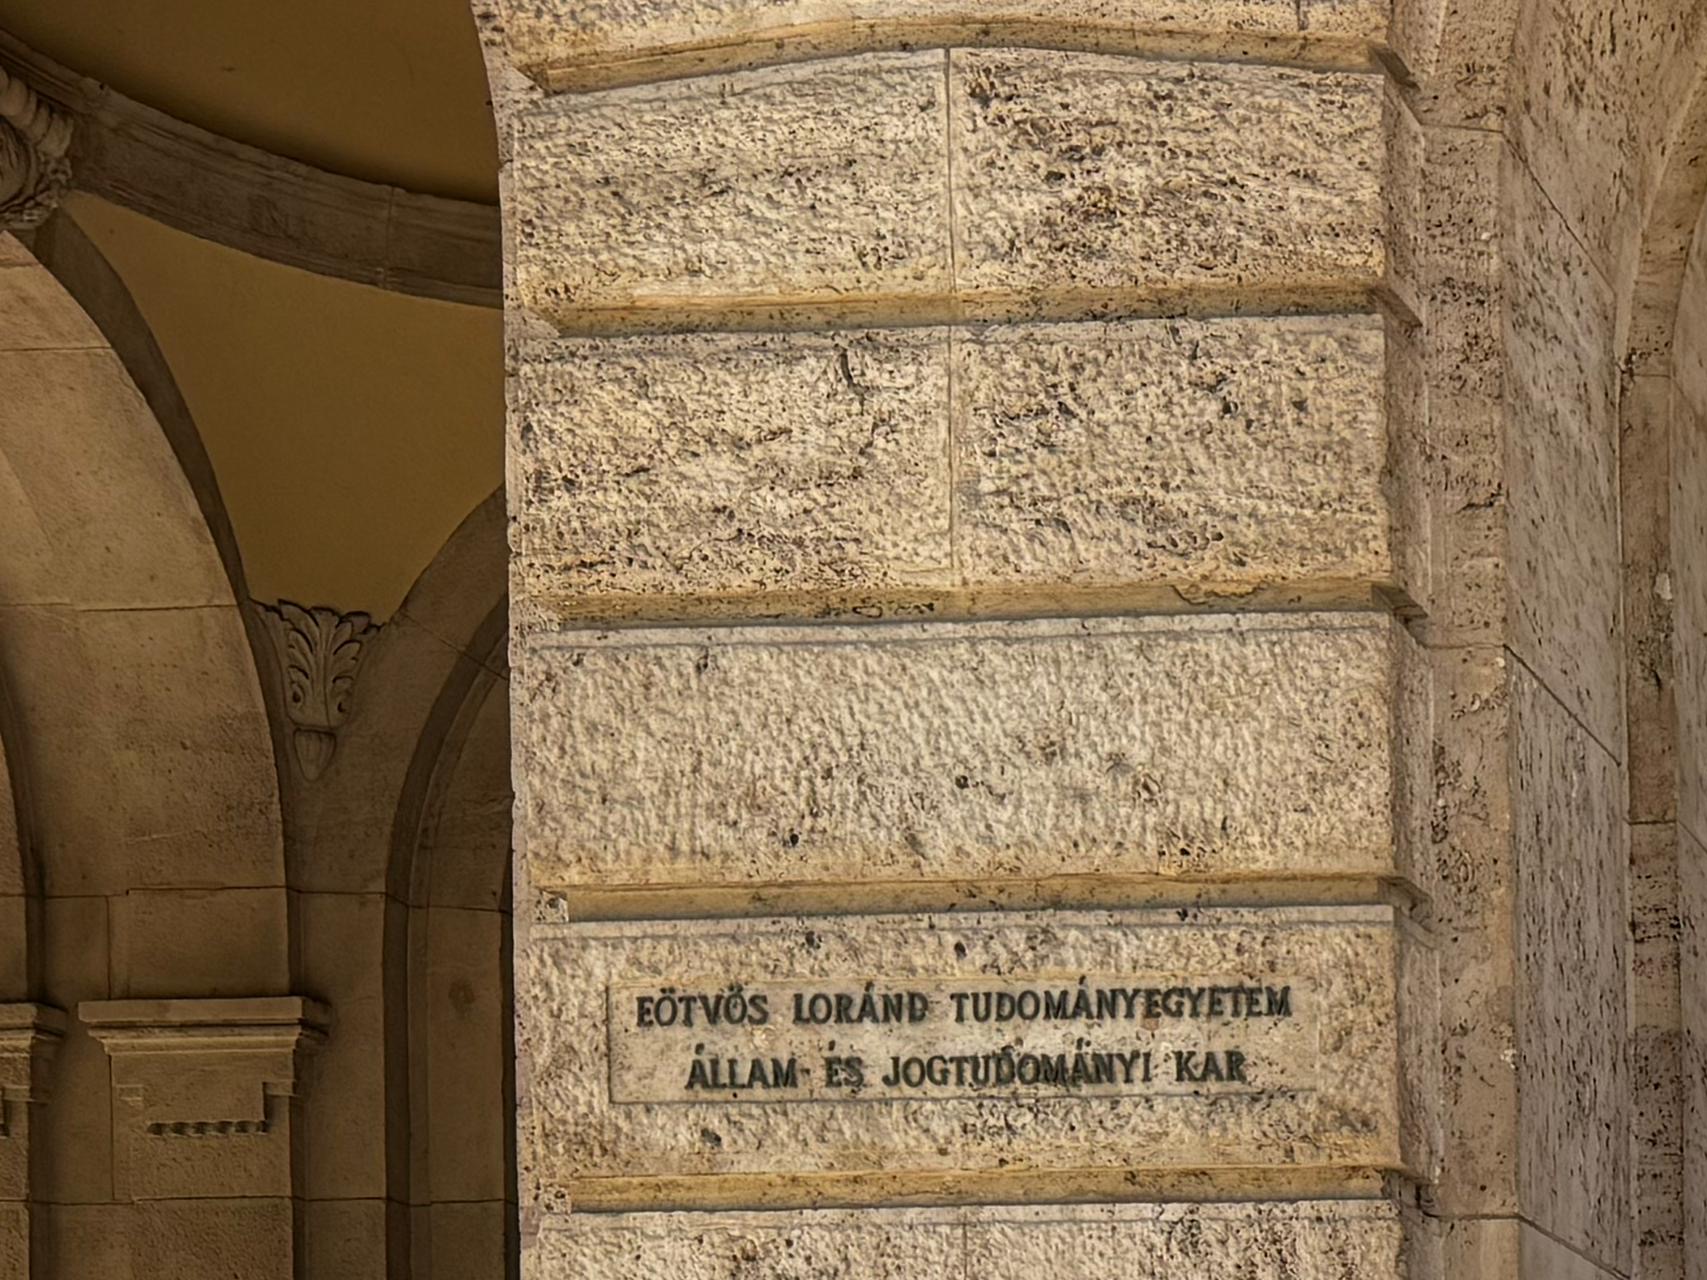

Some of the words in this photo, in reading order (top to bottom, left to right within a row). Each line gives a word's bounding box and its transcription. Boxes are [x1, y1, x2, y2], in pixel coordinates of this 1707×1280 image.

[635, 982, 769, 1028] EÖTVÖS
[792, 981, 930, 1025] LORÁND
[950, 975, 1293, 1024] TUDOMÁNYEGYETEM
[823, 1039, 865, 1088] ÉS
[882, 1037, 1153, 1088] JOGTUDOMÁNYI
[1175, 1050, 1249, 1083] KAR
